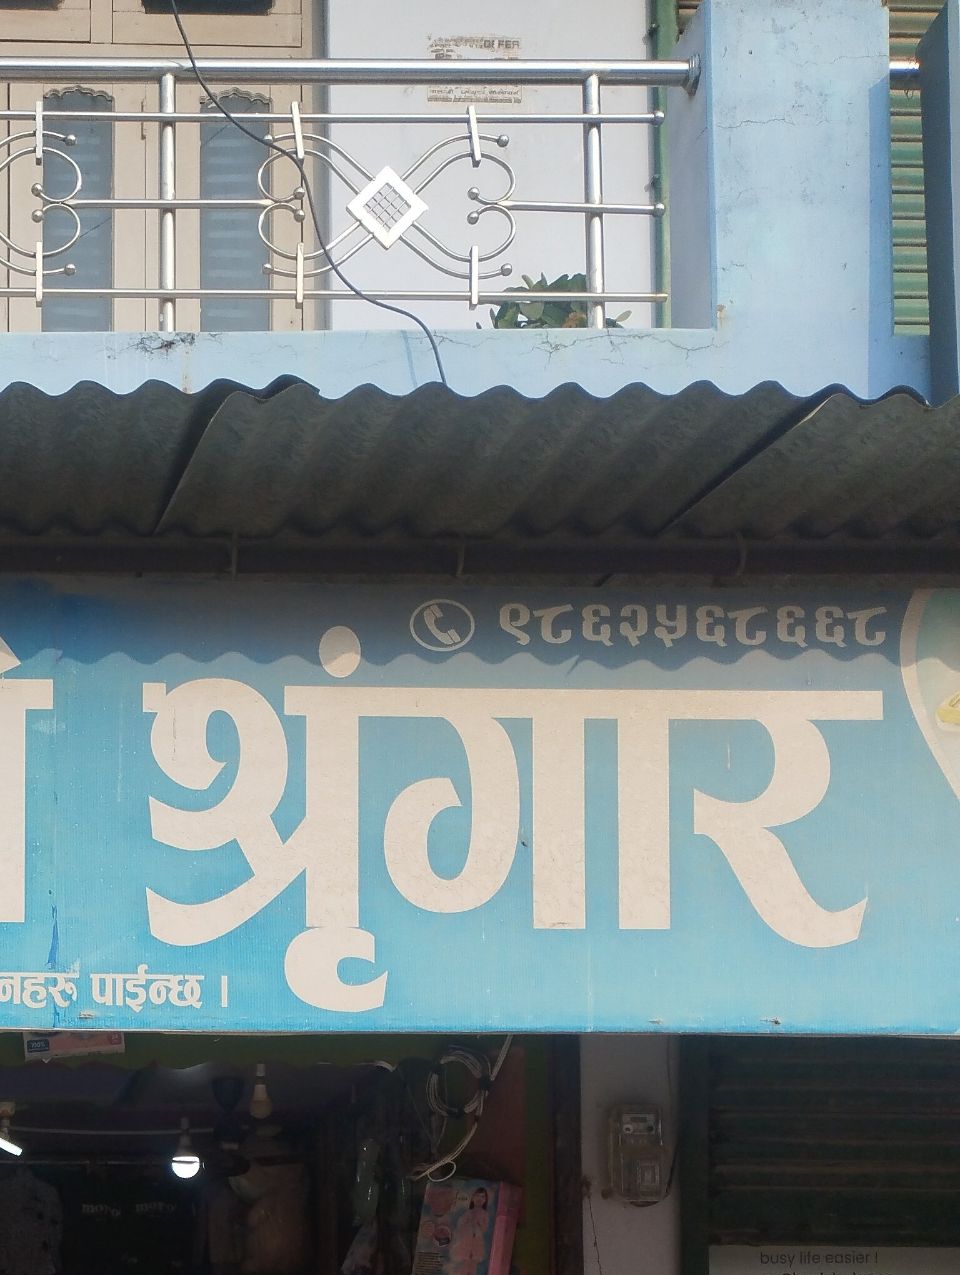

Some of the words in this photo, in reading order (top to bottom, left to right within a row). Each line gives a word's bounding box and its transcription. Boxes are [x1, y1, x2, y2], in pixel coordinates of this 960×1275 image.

[499, 603, 888, 648] ९८६२५६८६६८
[89, 964, 205, 1013] पाईन्छ
[760, 1252, 796, 1268] busy
[799, 1251, 821, 1264] life
[825, 1251, 871, 1265] easier
